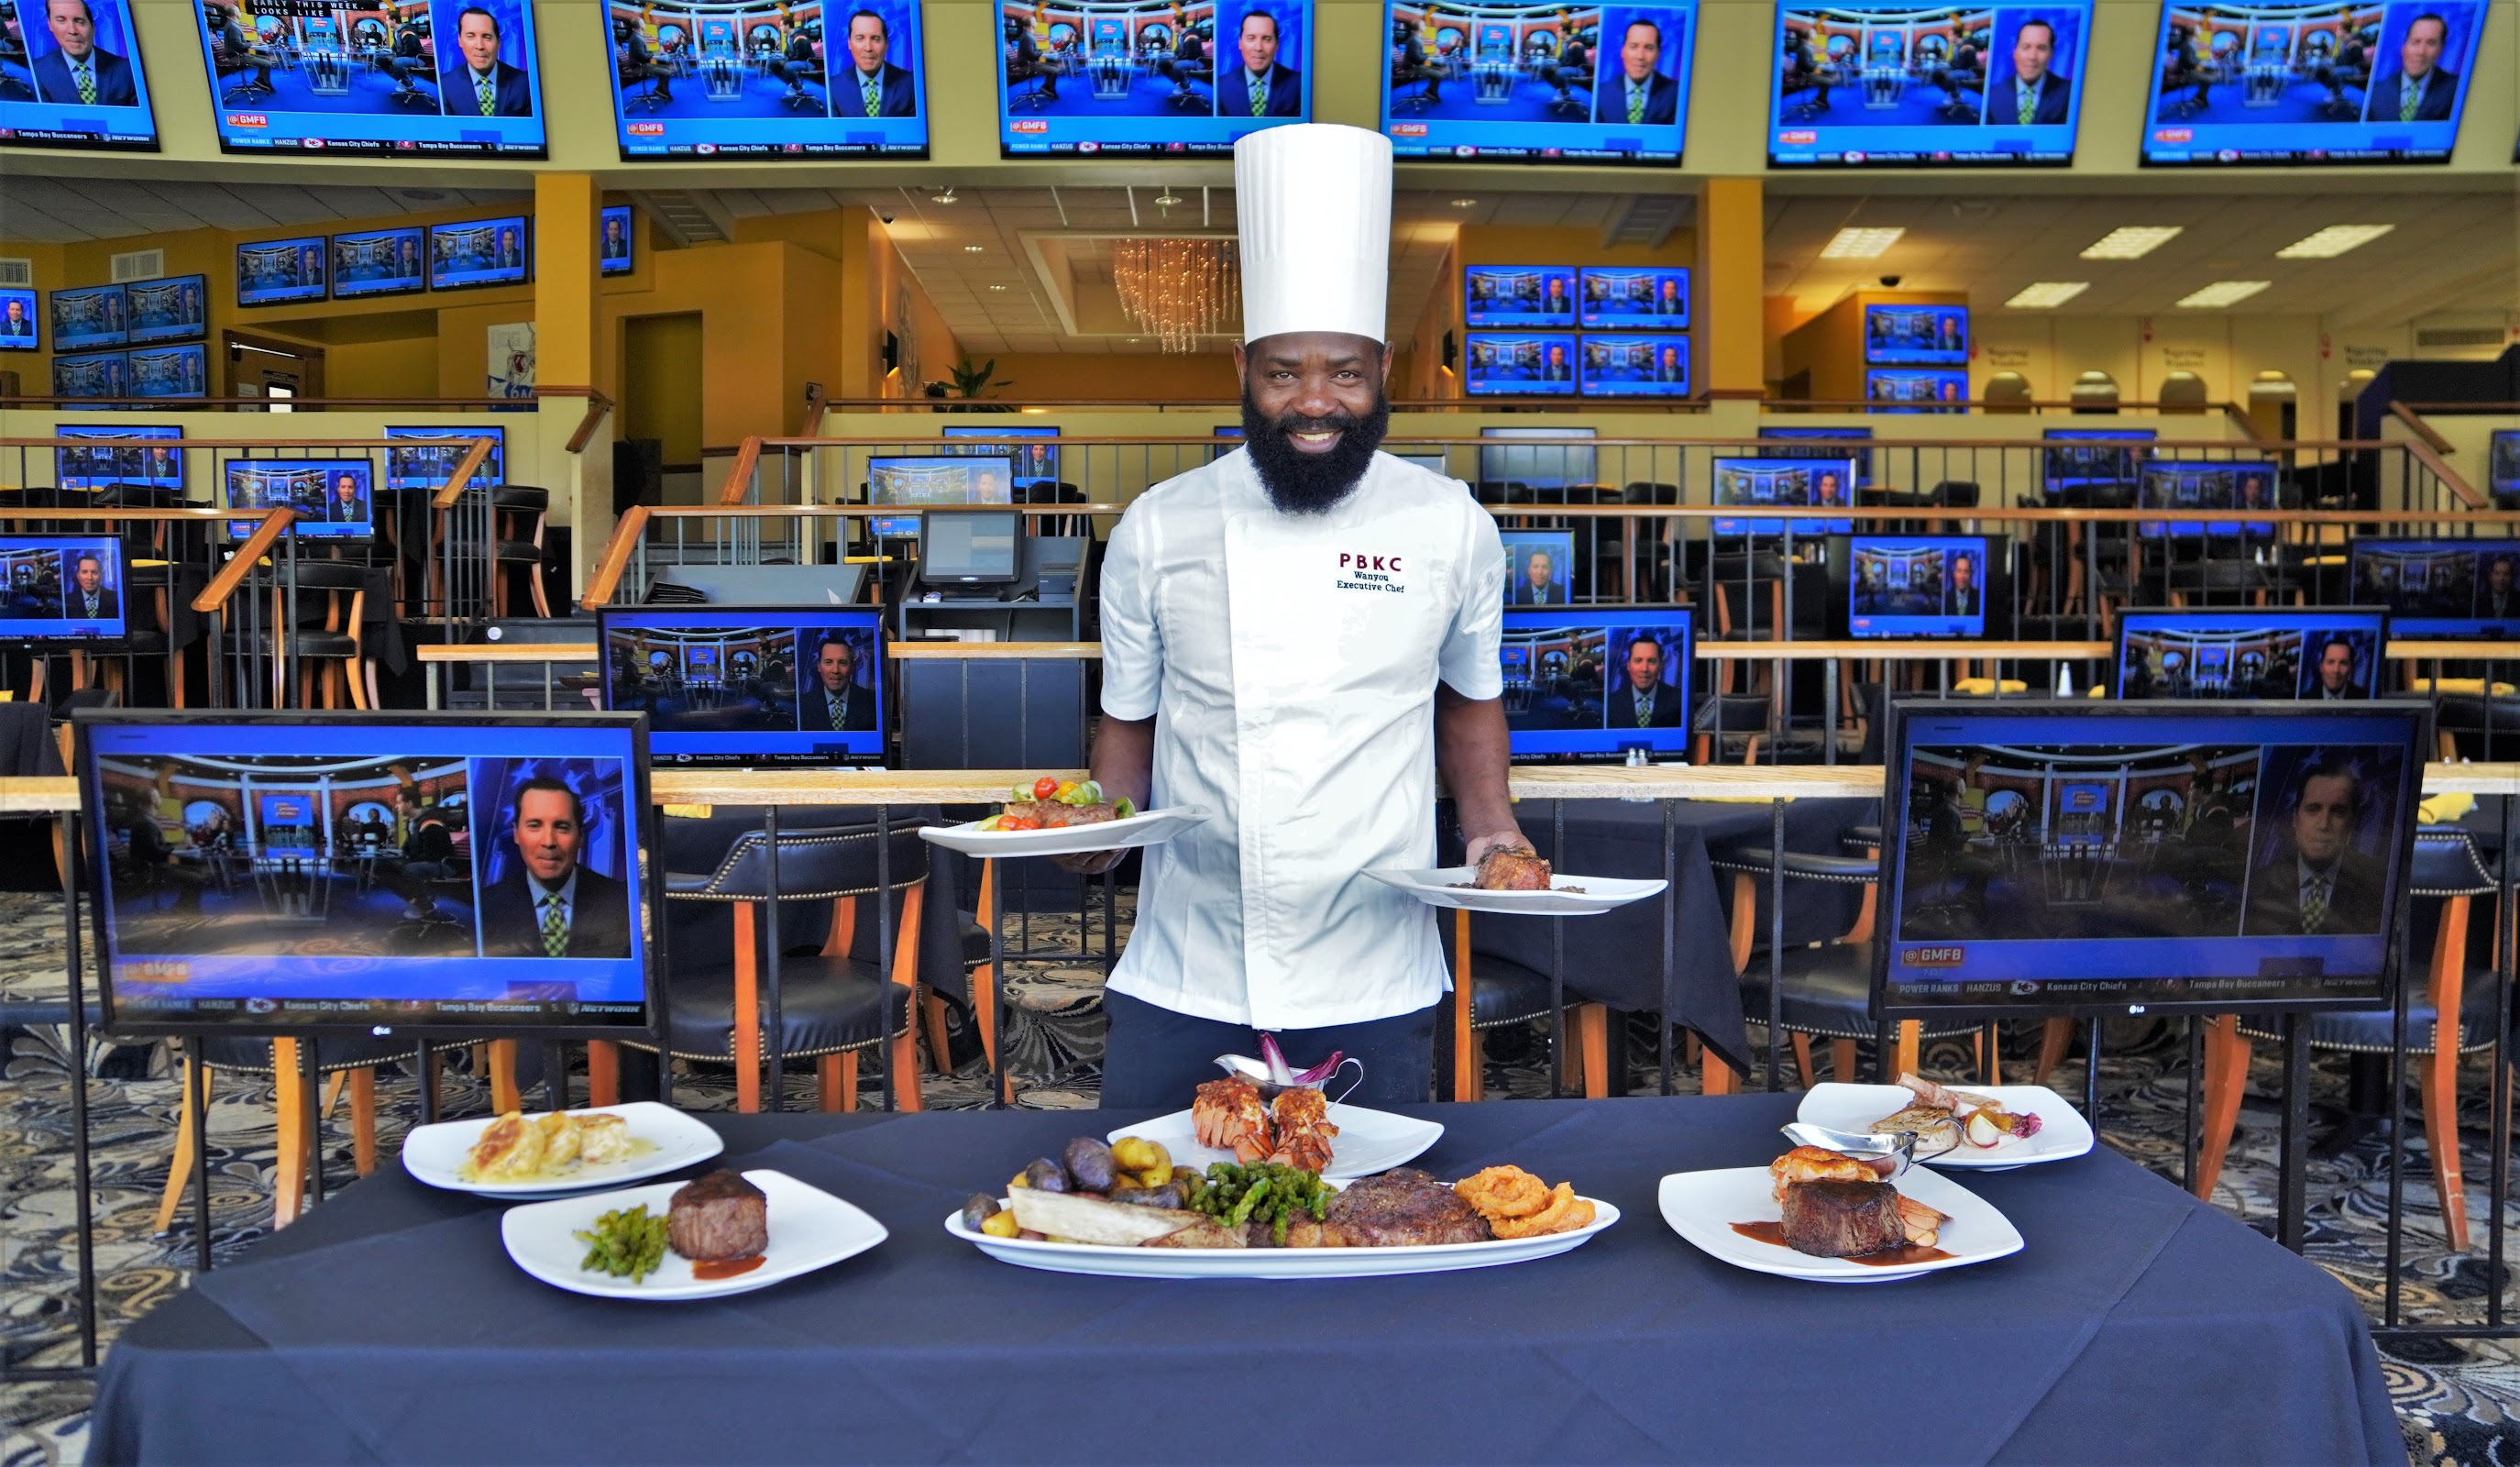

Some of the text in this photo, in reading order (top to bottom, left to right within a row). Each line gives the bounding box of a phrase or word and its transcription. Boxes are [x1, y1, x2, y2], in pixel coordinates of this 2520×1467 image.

[17, 130, 39, 138] Tampa
[39, 131, 51, 139] Bay
[349, 140, 360, 149] City
[1354, 570, 1389, 582] Wanyou
[1337, 579, 1405, 593] Executive Chef
[1899, 984, 1959, 993] POWER RANKS
[1966, 983, 2001, 992] HANZUS
[2047, 982, 2078, 991] Kansas
[2080, 981, 2097, 992] City
[2099, 981, 2127, 990] Chiefs
[2189, 979, 2217, 989] Tampa
[2218, 978, 2235, 989] Bay
[2237, 978, 2286, 988] Buccaneers
[198, 1000, 236, 1009] HANZUS
[284, 1001, 318, 1009] Kansas
[320, 1000, 337, 1011] City
[436, 1002, 467, 1012] Tampa
[468, 1002, 484, 1013] Bay
[487, 1003, 542, 1012] Buccaneers
